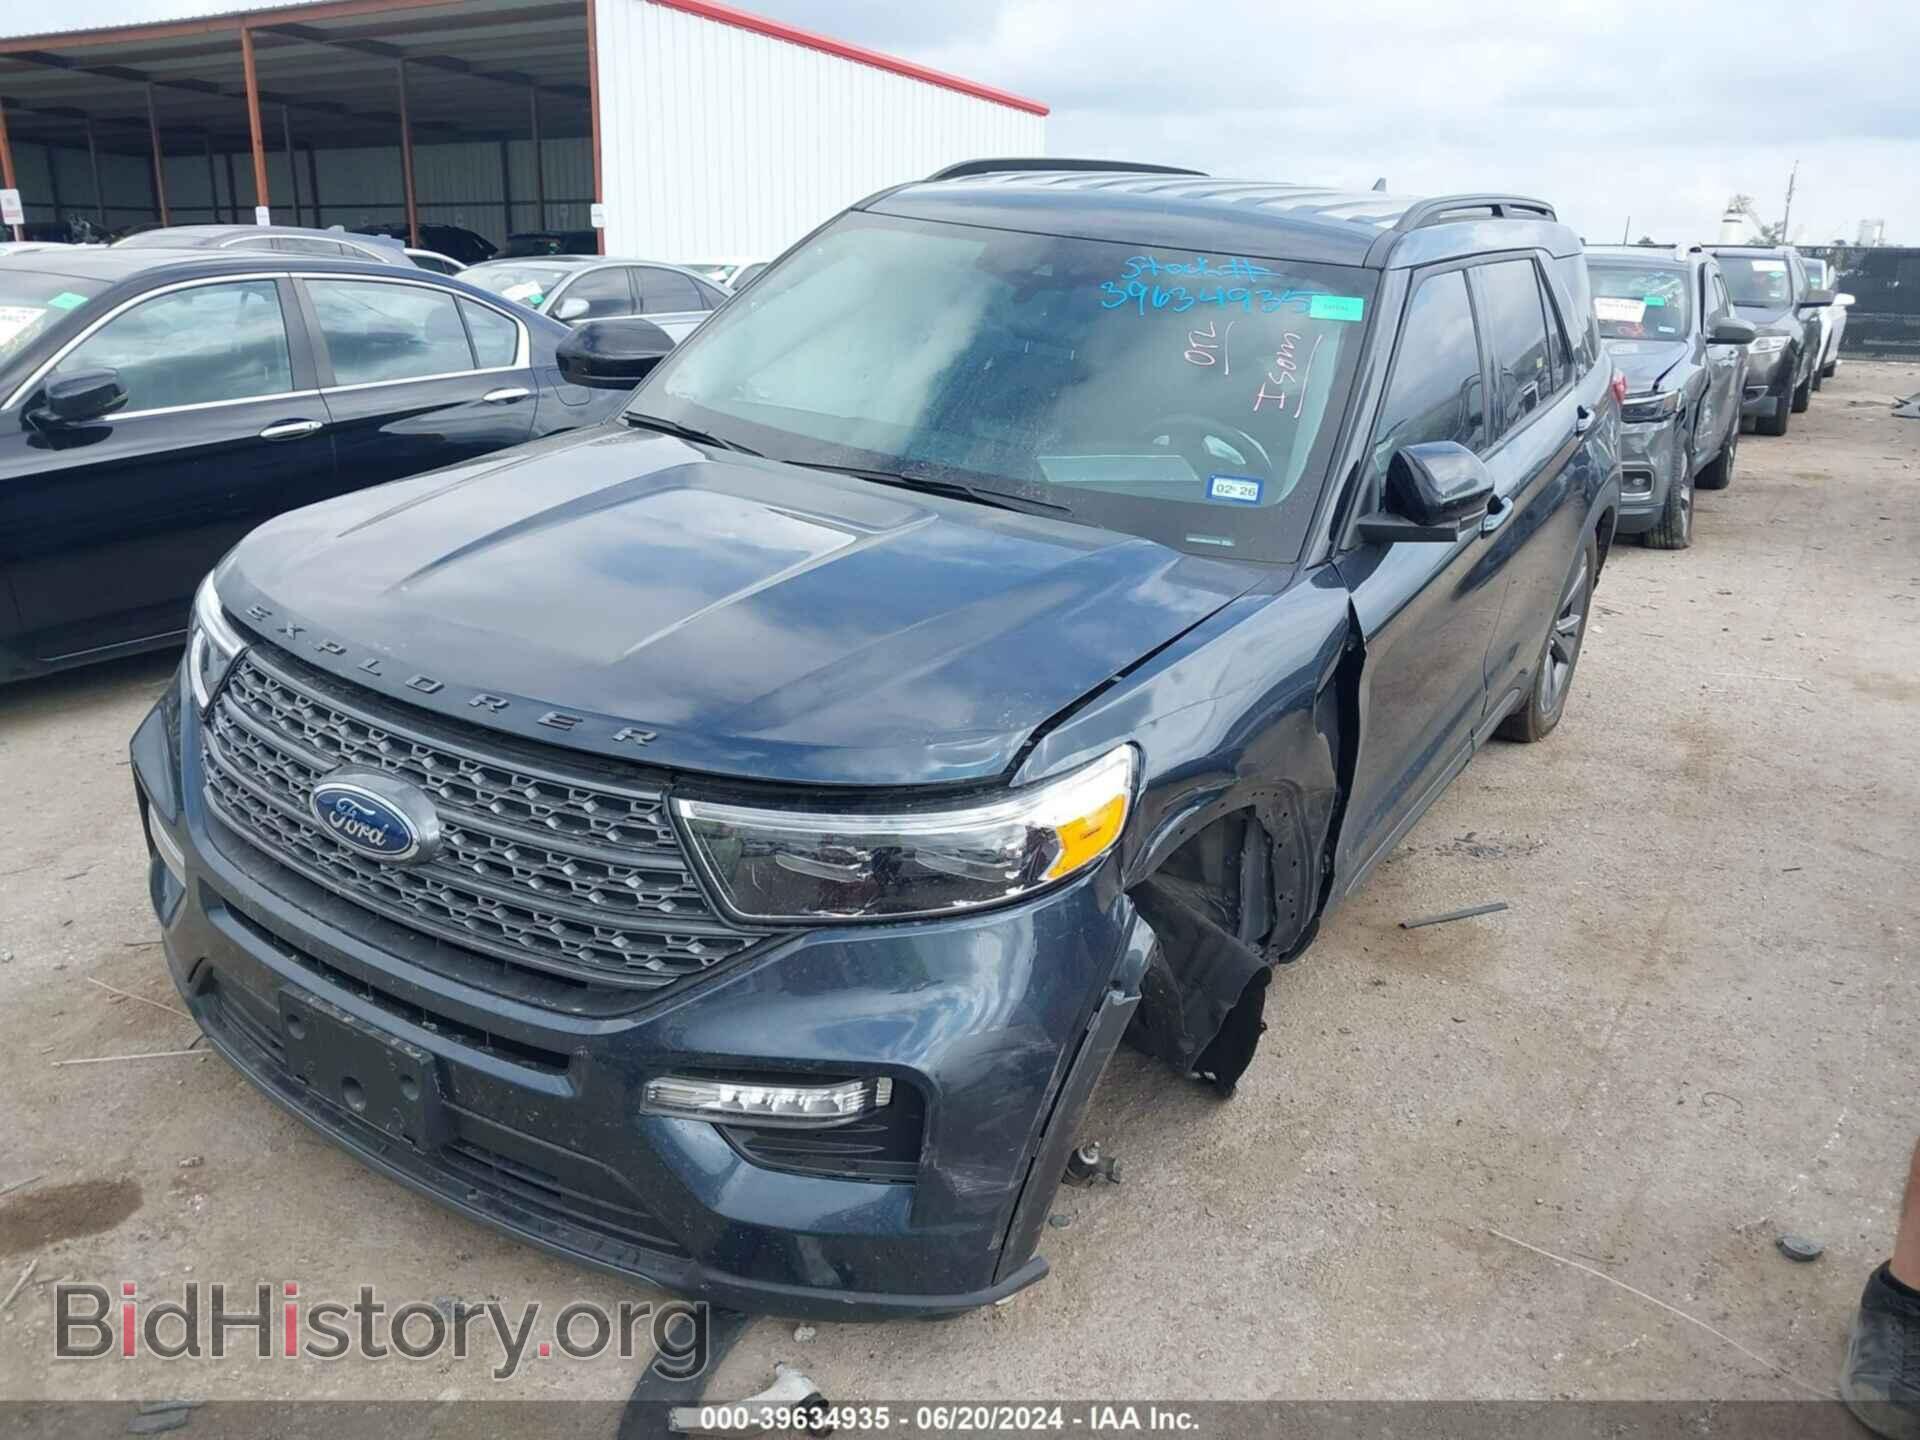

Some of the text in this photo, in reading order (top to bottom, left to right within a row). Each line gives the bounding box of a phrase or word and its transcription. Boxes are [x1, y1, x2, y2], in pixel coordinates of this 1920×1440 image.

[1100, 281, 1330, 316] 39634935
[246, 604, 658, 746] EXPLORER
[326, 797, 387, 847] Ford
